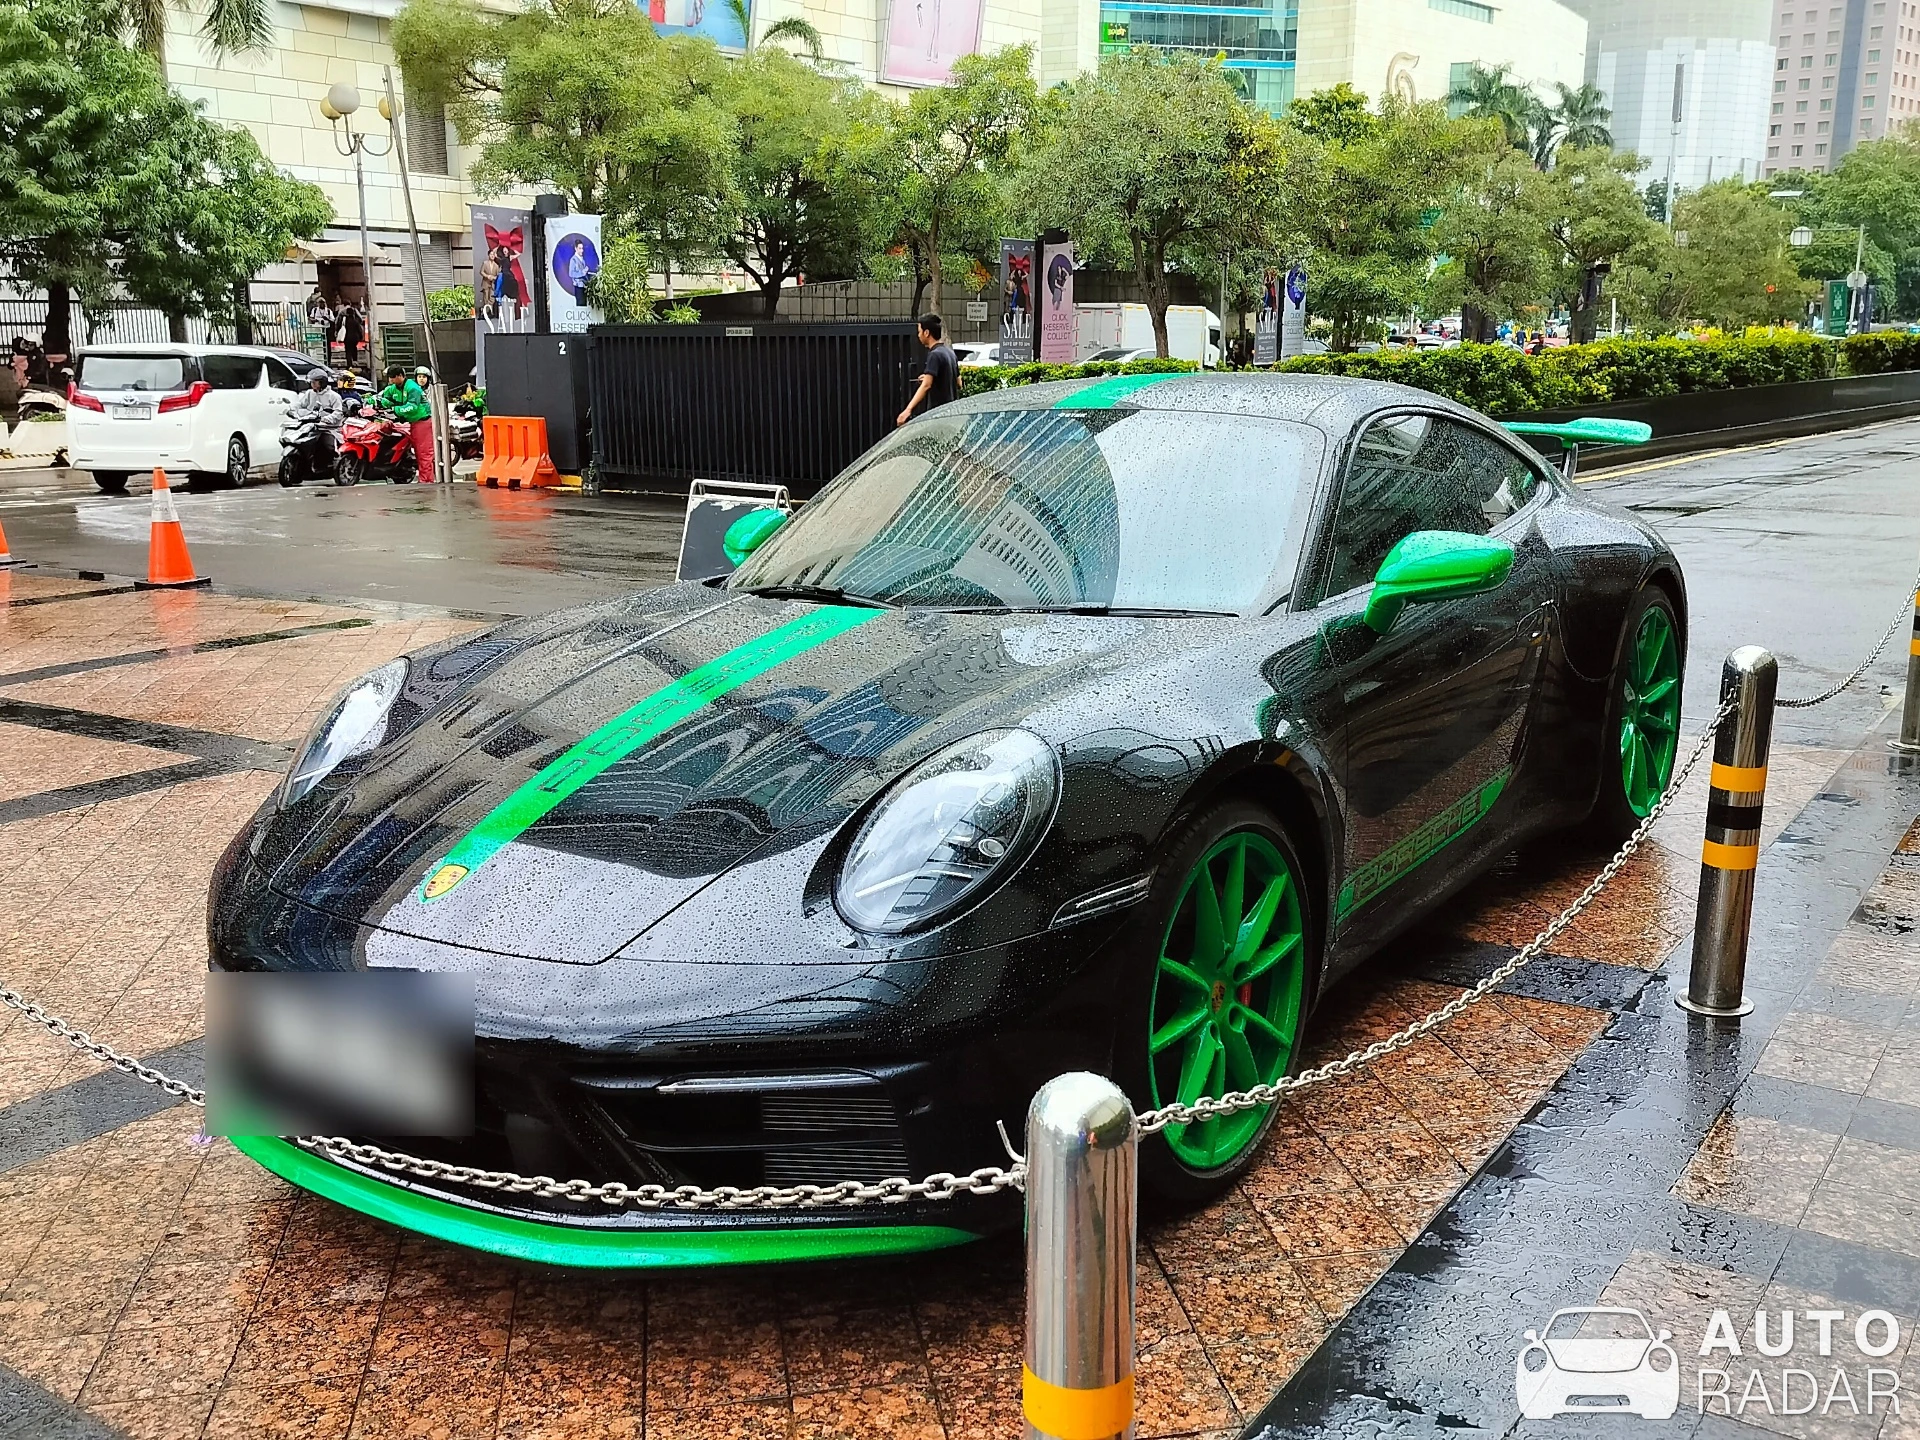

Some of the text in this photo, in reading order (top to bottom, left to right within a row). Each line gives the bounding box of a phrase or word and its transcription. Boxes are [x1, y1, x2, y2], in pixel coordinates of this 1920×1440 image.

[566, 310, 592, 321] CLICK
[1003, 312, 1032, 339] SALE
[558, 341, 567, 355] 2
[1355, 793, 1478, 900] PORSCHE
